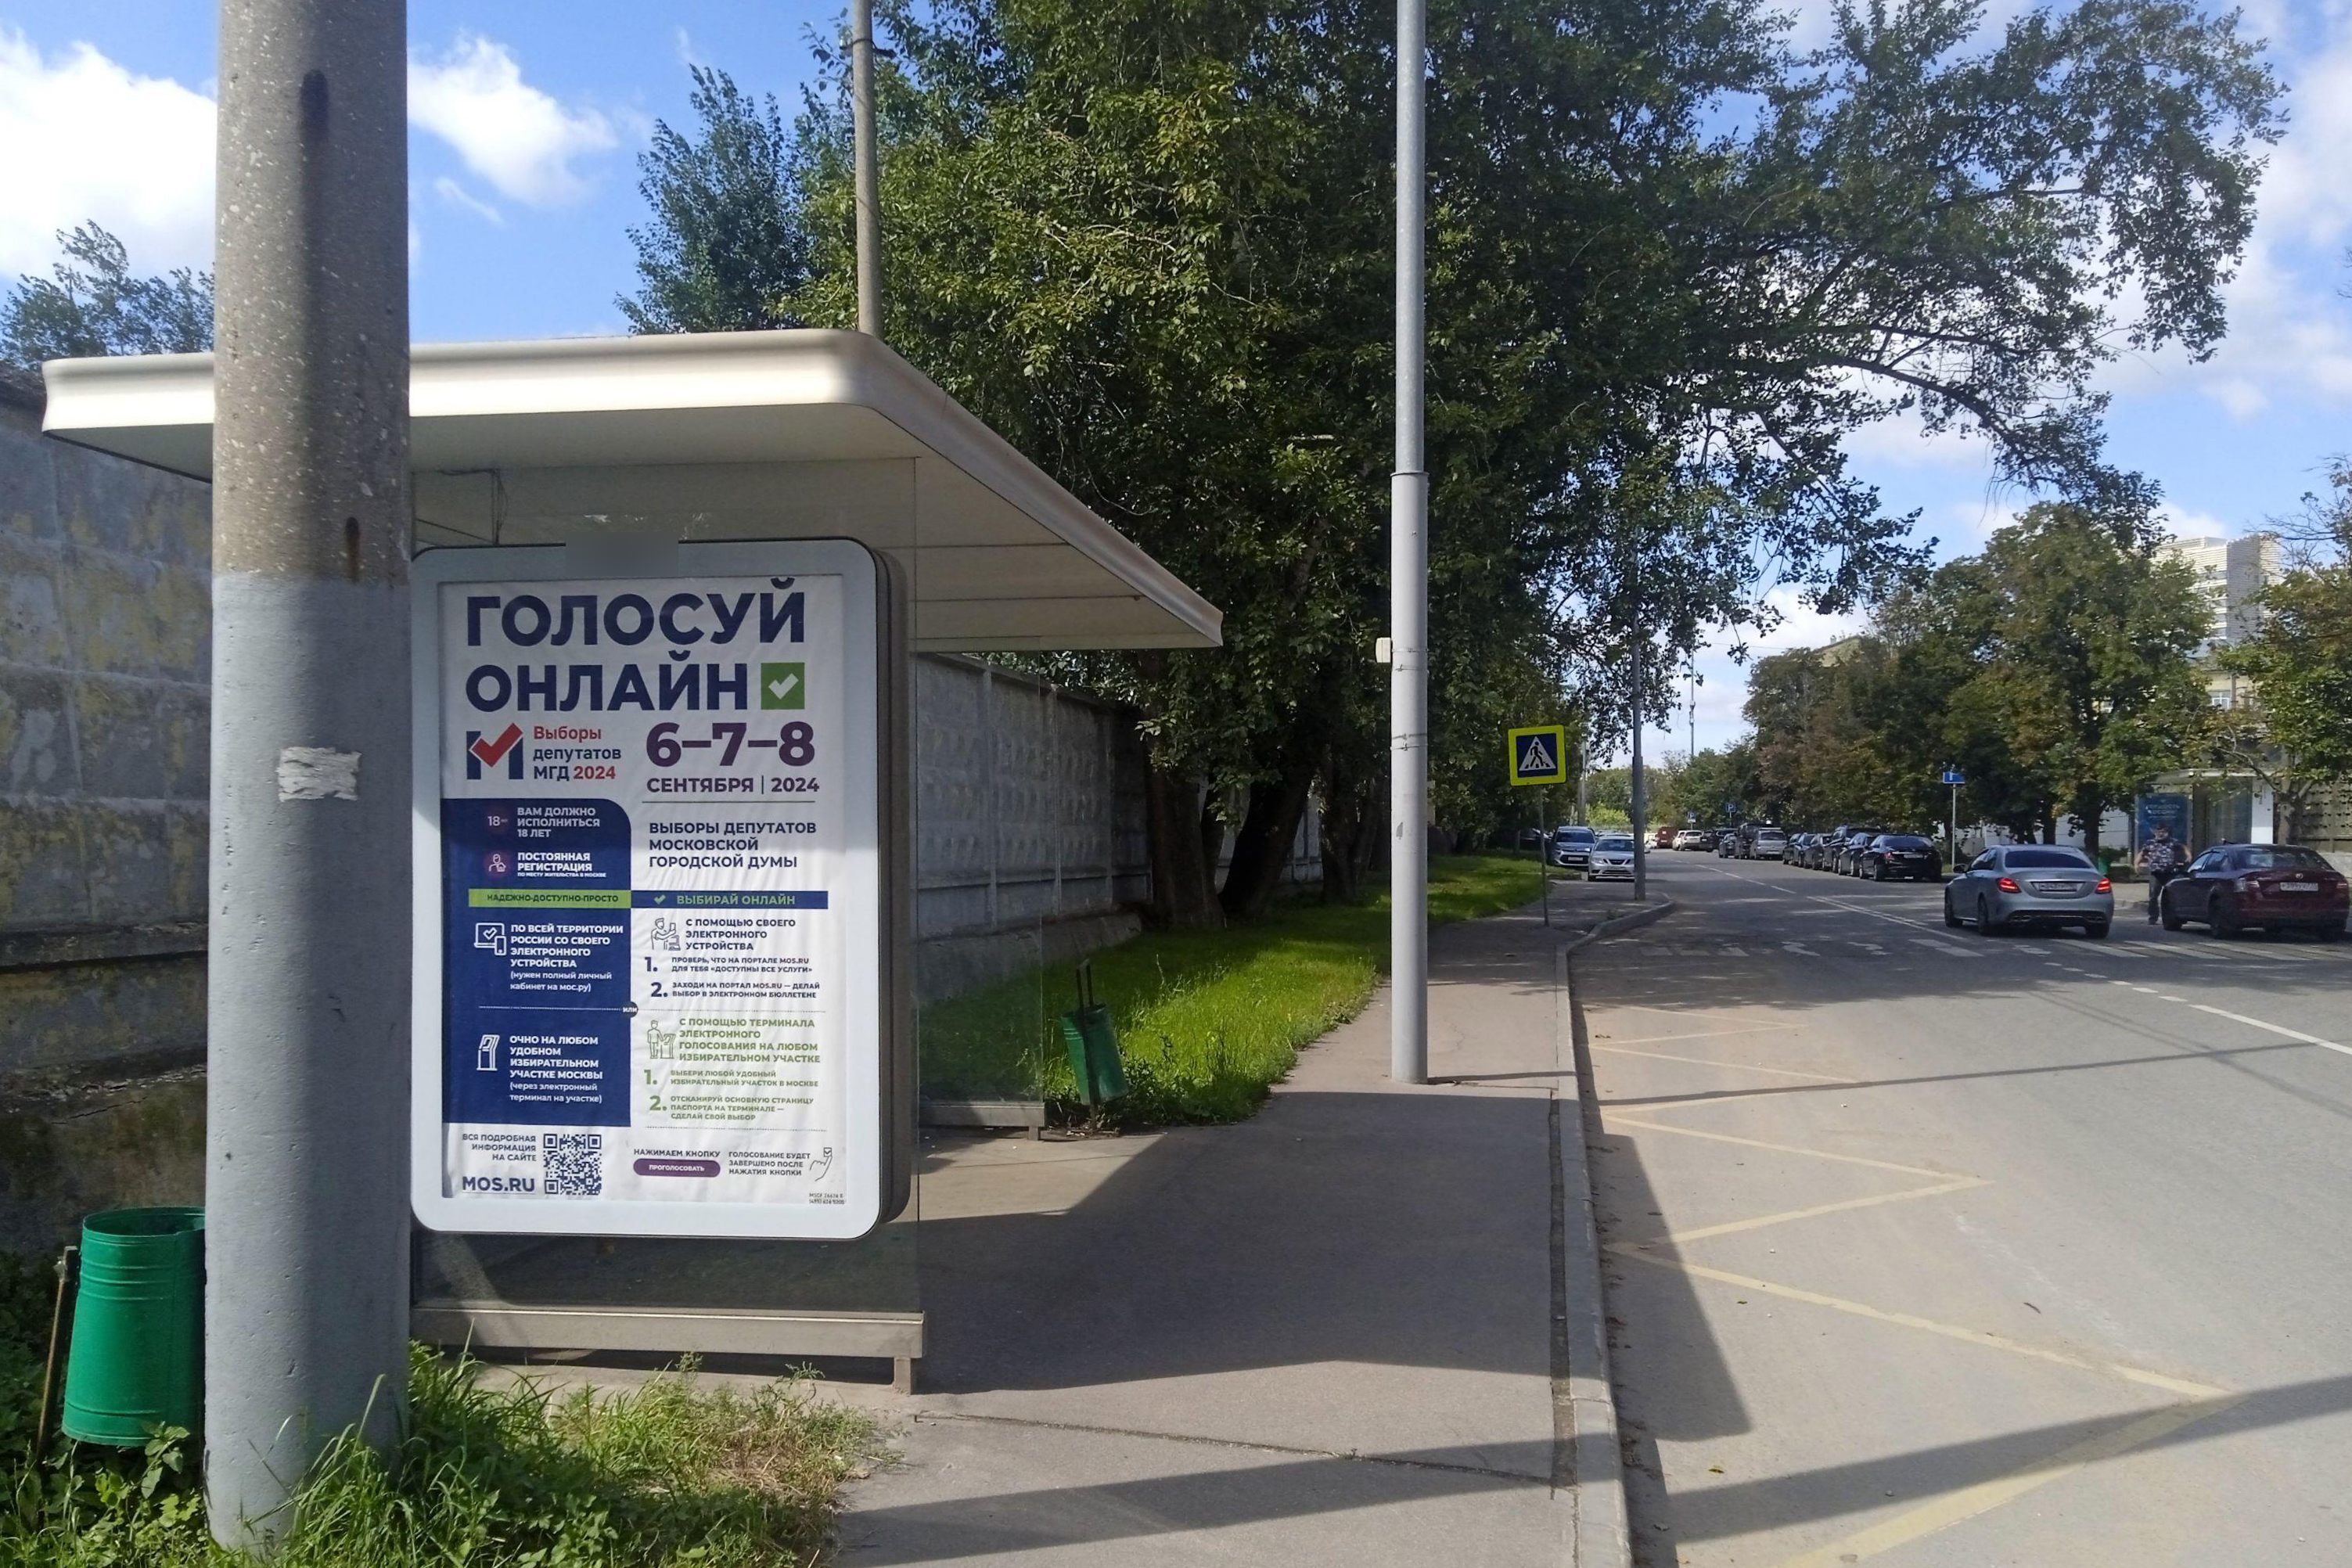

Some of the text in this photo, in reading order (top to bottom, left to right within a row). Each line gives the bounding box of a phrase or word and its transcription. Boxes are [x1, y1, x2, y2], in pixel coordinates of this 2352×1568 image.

[468, 577, 804, 646] ГОЛОСУЙ
[466, 650, 747, 712] ОНЛАЙН
[534, 726, 602, 740] Выборы
[533, 746, 621, 762] депутатов
[534, 765, 616, 782] МГД 2024
[647, 777, 820, 793] СЕНТЯБРЯ 2024
[545, 807, 595, 817] ДОЛЖНО
[517, 818, 600, 827] ИСПОЛНИТЬСЯ
[649, 822, 816, 835] ВЫБОРЫ ДЕПУТАТОВ
[649, 837, 758, 851] МОСКОВСКОЙ
[518, 852, 590, 861] ПОСТОЯННАЯ
[649, 854, 797, 869] ГОРОДСКОЙ ДУМЫ
[518, 863, 592, 872] РЕГИСТРАЦИЯ
[677, 893, 795, 904] ВЫБИРАЙ ОНЛАЙН
[528, 923, 555, 933] ВСЕЙ
[695, 919, 753, 928] ПОМОЩЬЮ
[571, 937, 610, 945] СВОЕГО
[685, 940, 753, 951] УСТРОЙСТВА
[510, 948, 591, 956] ЭЛЕКТРОННОГО
[510, 958, 577, 968] УСТРОЙСТВА
[645, 957, 658, 972] 1.
[511, 971, 541, 980] (нужен
[650, 982, 668, 998] 2.
[689, 1019, 747, 1027] ПОМОЩЬЮ
[510, 1035, 539, 1044] ОЧНО
[558, 1036, 599, 1045] ЛЮБОМ
[509, 1047, 561, 1056] УДОБНОМ
[679, 1042, 756, 1051] ГОЛОСОВАНИЯ
[510, 1059, 599, 1067] ИЗБИРАТЕЛЬНОМ
[679, 1054, 821, 1063] ИЗБИРАТЕЛЬНОМ УЧАСТКЕ
[509, 1070, 556, 1079] УЧАСТКЕ
[644, 1070, 657, 1084] 1.
[510, 1082, 597, 1091] (через электронный
[565, 1095, 602, 1104] участке)
[649, 1095, 667, 1111] 2.
[507, 1153, 537, 1161] САЙТЕ
[786, 1152, 811, 1160] БУДЕТ
[462, 1176, 535, 1192] MOS.RU
